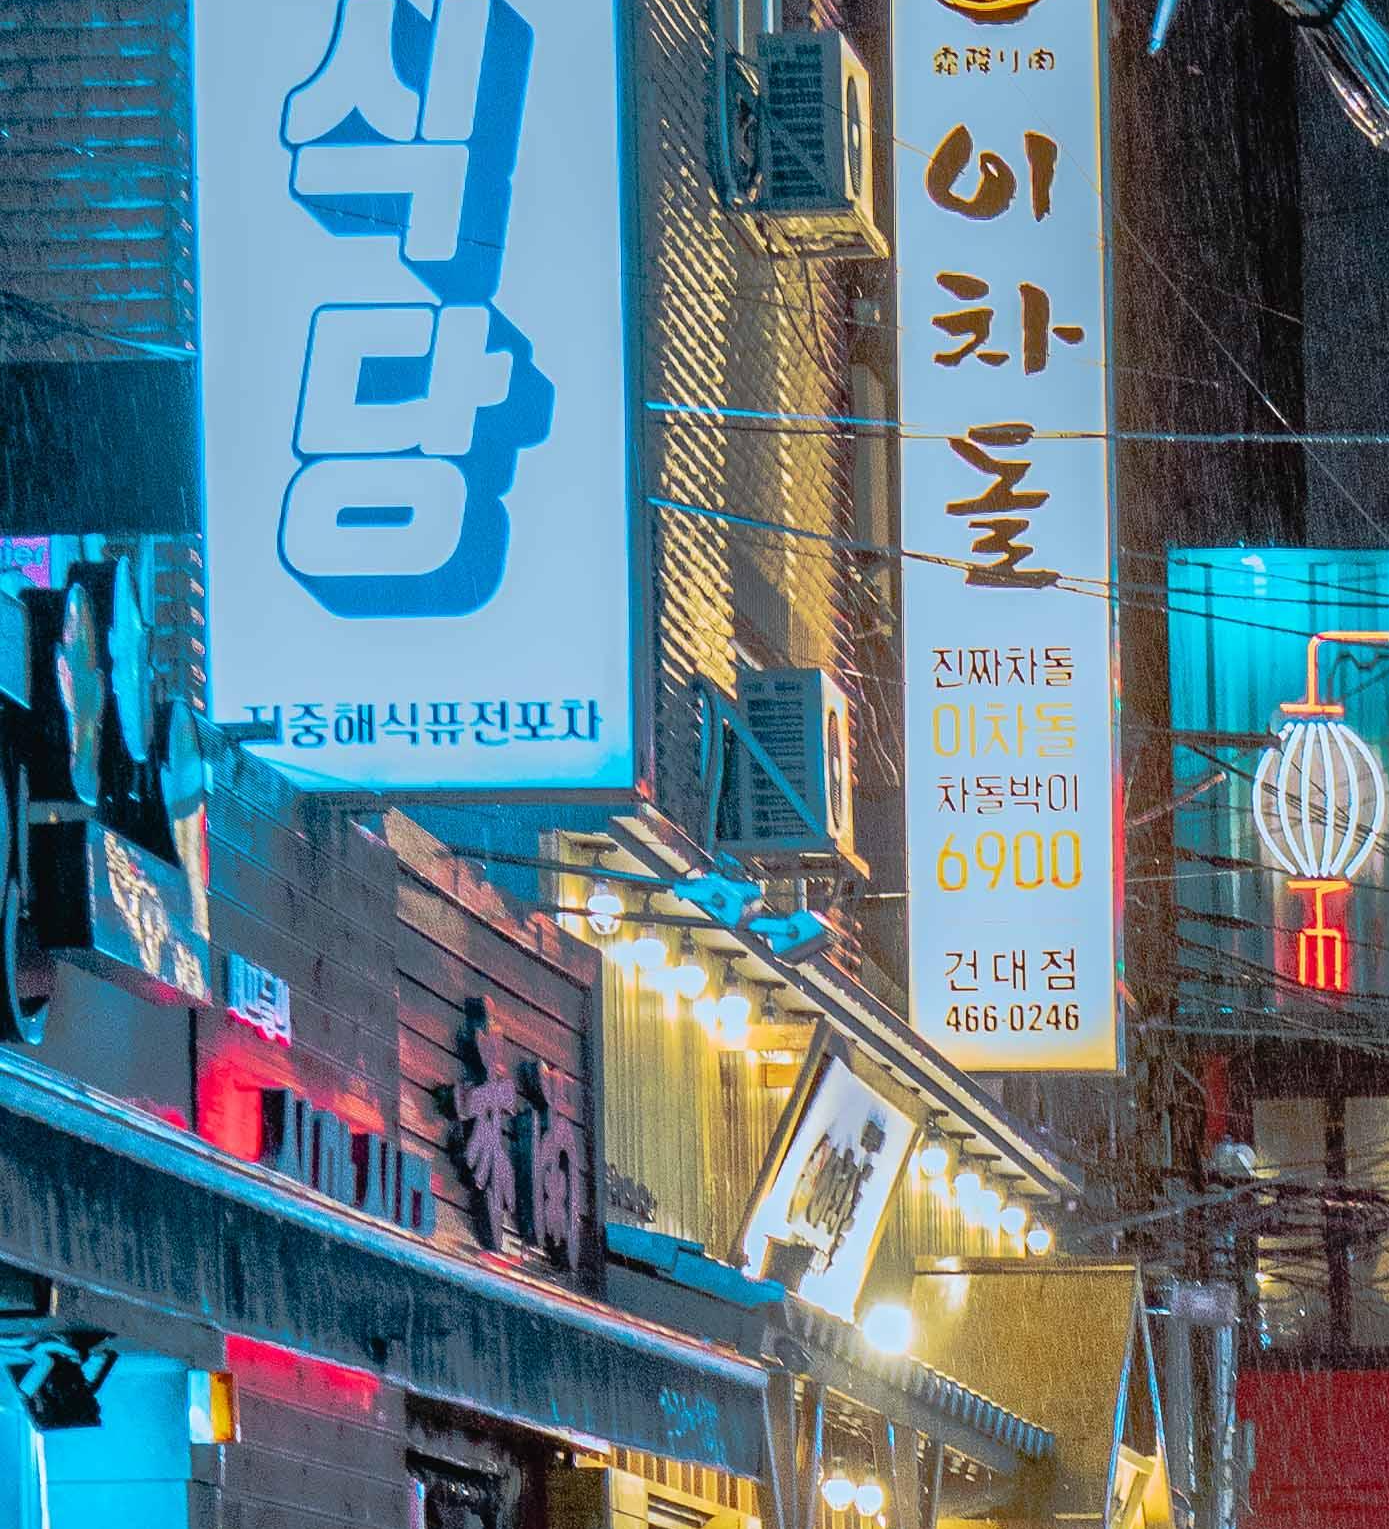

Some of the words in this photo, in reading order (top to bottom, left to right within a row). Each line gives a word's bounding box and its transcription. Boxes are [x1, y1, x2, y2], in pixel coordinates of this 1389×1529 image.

[926, 124, 1087, 587] 이차돌
[931, 647, 1074, 688] 진짜차돌
[932, 702, 1078, 758] 이차돌
[938, 773, 1079, 814] 차돌박이
[936, 830, 1082, 892] 6900
